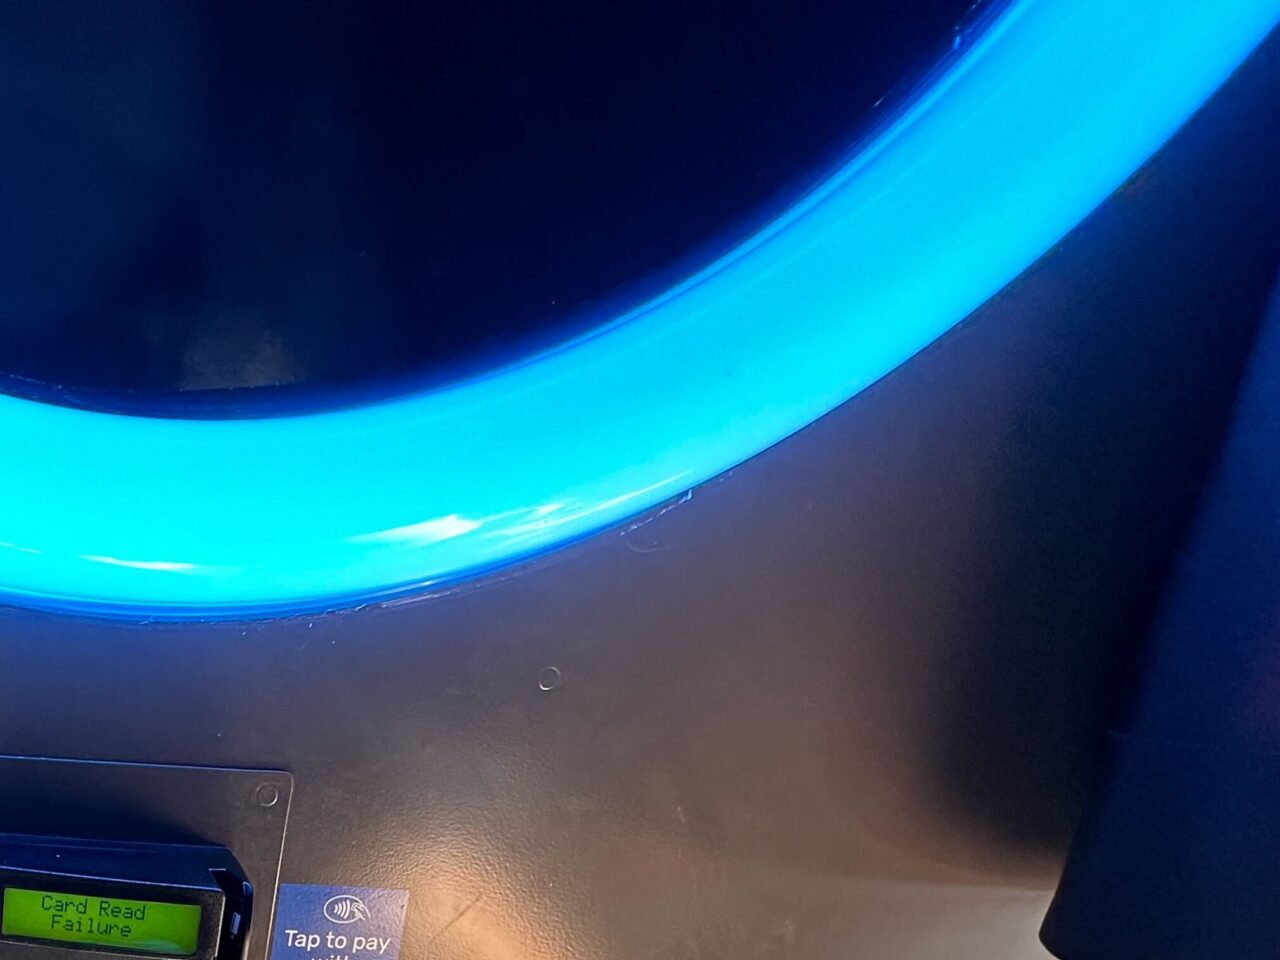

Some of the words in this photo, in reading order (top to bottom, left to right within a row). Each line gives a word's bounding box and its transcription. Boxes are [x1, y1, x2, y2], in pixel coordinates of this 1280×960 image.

[41, 895, 88, 915] Card
[98, 900, 146, 921] Read
[51, 914, 132, 937] Failure
[284, 929, 320, 951] Tap
[326, 931, 347, 949] to
[352, 936, 391, 954] pay
